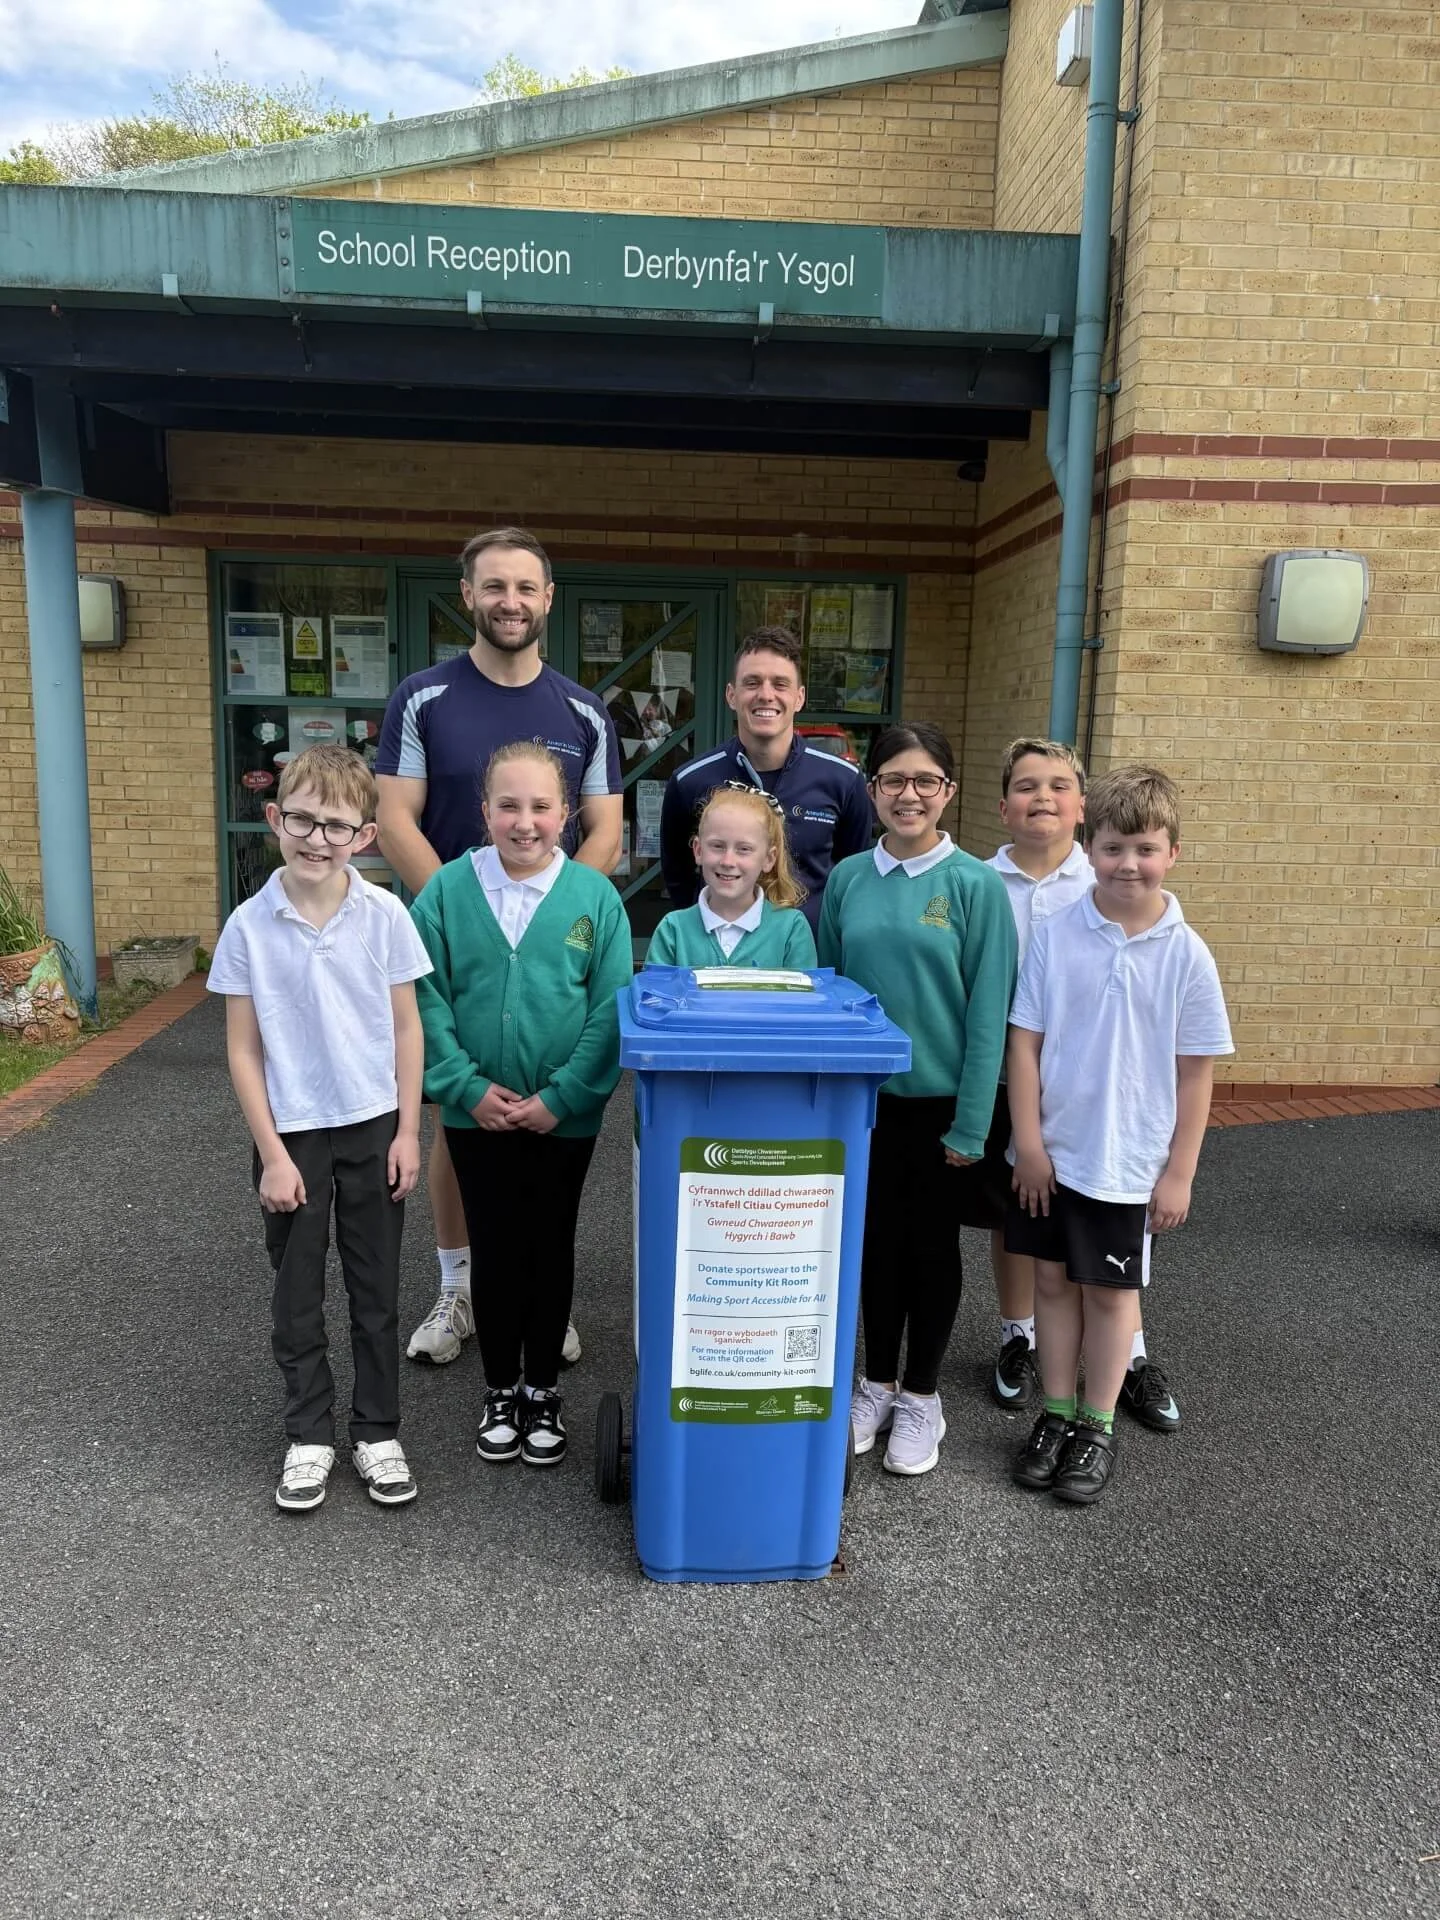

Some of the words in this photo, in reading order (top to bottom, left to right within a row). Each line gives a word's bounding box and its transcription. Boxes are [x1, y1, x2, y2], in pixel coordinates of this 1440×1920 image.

[317, 229, 417, 268] School
[427, 236, 572, 280] Reception
[623, 245, 770, 289] Derbynfa'r
[778, 252, 856, 294] Ysgol
[688, 1185, 745, 1197] Cyfrannwch
[748, 1187, 781, 1197] ddillad
[784, 1187, 834, 1197] chwaraeon
[693, 1199, 701, 1207] i'r
[704, 1199, 741, 1209] Ystafell
[743, 1201, 772, 1210] Citiau
[774, 1200, 829, 1211] Cymunedol
[707, 1218, 746, 1227] Gwneud
[748, 1219, 800, 1228] Chwaraeon
[802, 1220, 813, 1228] yn
[725, 1231, 763, 1242] Hygyrch
[765, 1232, 769, 1240] i
[770, 1232, 795, 1240] Bawb
[698, 1264, 733, 1274] Donate
[736, 1266, 788, 1278] sportswear
[802, 1264, 818, 1272] the
[706, 1277, 763, 1288] Community
[766, 1278, 779, 1287] Kit
[781, 1278, 809, 1286] Room
[687, 1293, 722, 1305] Making
[725, 1296, 750, 1306] Sport
[751, 1295, 797, 1305] Accessible
[798, 1294, 812, 1303] for
[814, 1294, 826, 1303] All
[704, 1330, 725, 1338] ragor
[734, 1329, 778, 1338] wybodaeth
[714, 1336, 753, 1345] sganiwch:
[728, 1347, 774, 1355] information
